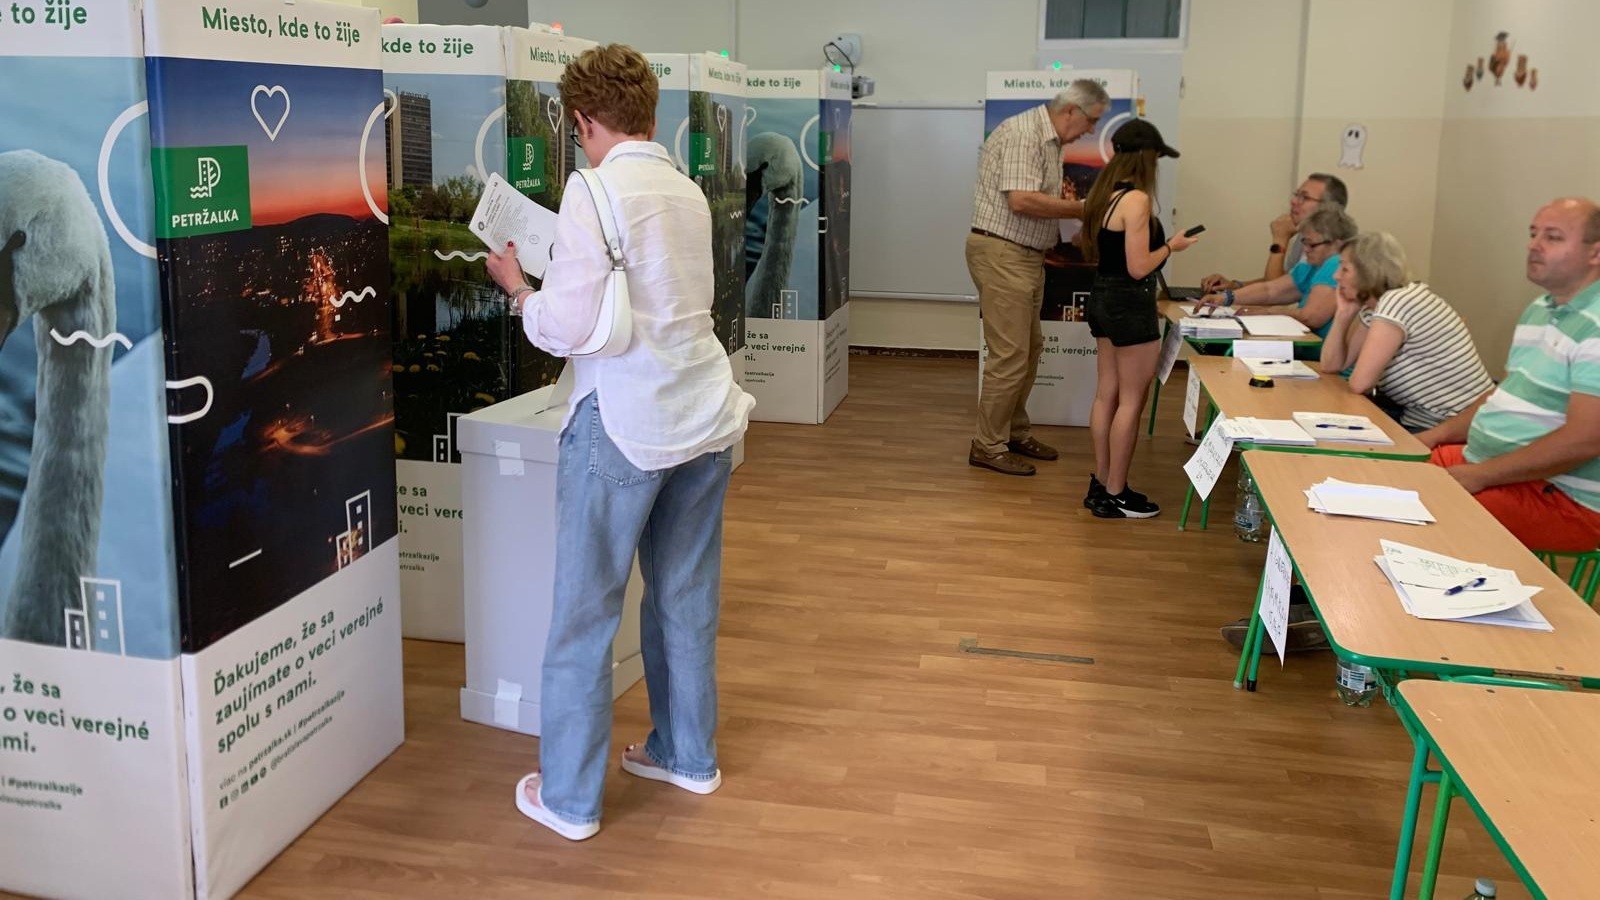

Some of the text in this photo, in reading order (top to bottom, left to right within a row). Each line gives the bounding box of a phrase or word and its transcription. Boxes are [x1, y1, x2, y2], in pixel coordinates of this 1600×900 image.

[11, 3, 35, 24] to
[45, 0, 87, 30] žije
[202, 6, 360, 47] Miesto, kde to žije
[381, 37, 474, 58] kde to žije
[530, 46, 556, 65] Miesto,
[746, 77, 801, 89] kde to žije
[1004, 79, 1045, 89] Miesto,
[1049, 79, 1069, 89] kde
[171, 208, 239, 228] PETRŽALKA
[747, 331, 756, 339] že
[751, 343, 769, 351] veci
[772, 344, 806, 353] verejné
[1062, 345, 1098, 356] verejné
[412, 487, 427, 497] sa
[400, 503, 429, 516] veci
[213, 610, 334, 696] Ďakujeme, že sa
[216, 596, 383, 725] zaujímate o veci verejné
[13, 672, 34, 694] že
[41, 683, 61, 699] sa
[217, 671, 317, 753] spolu s nami.
[3, 707, 149, 741] o veci verejné
